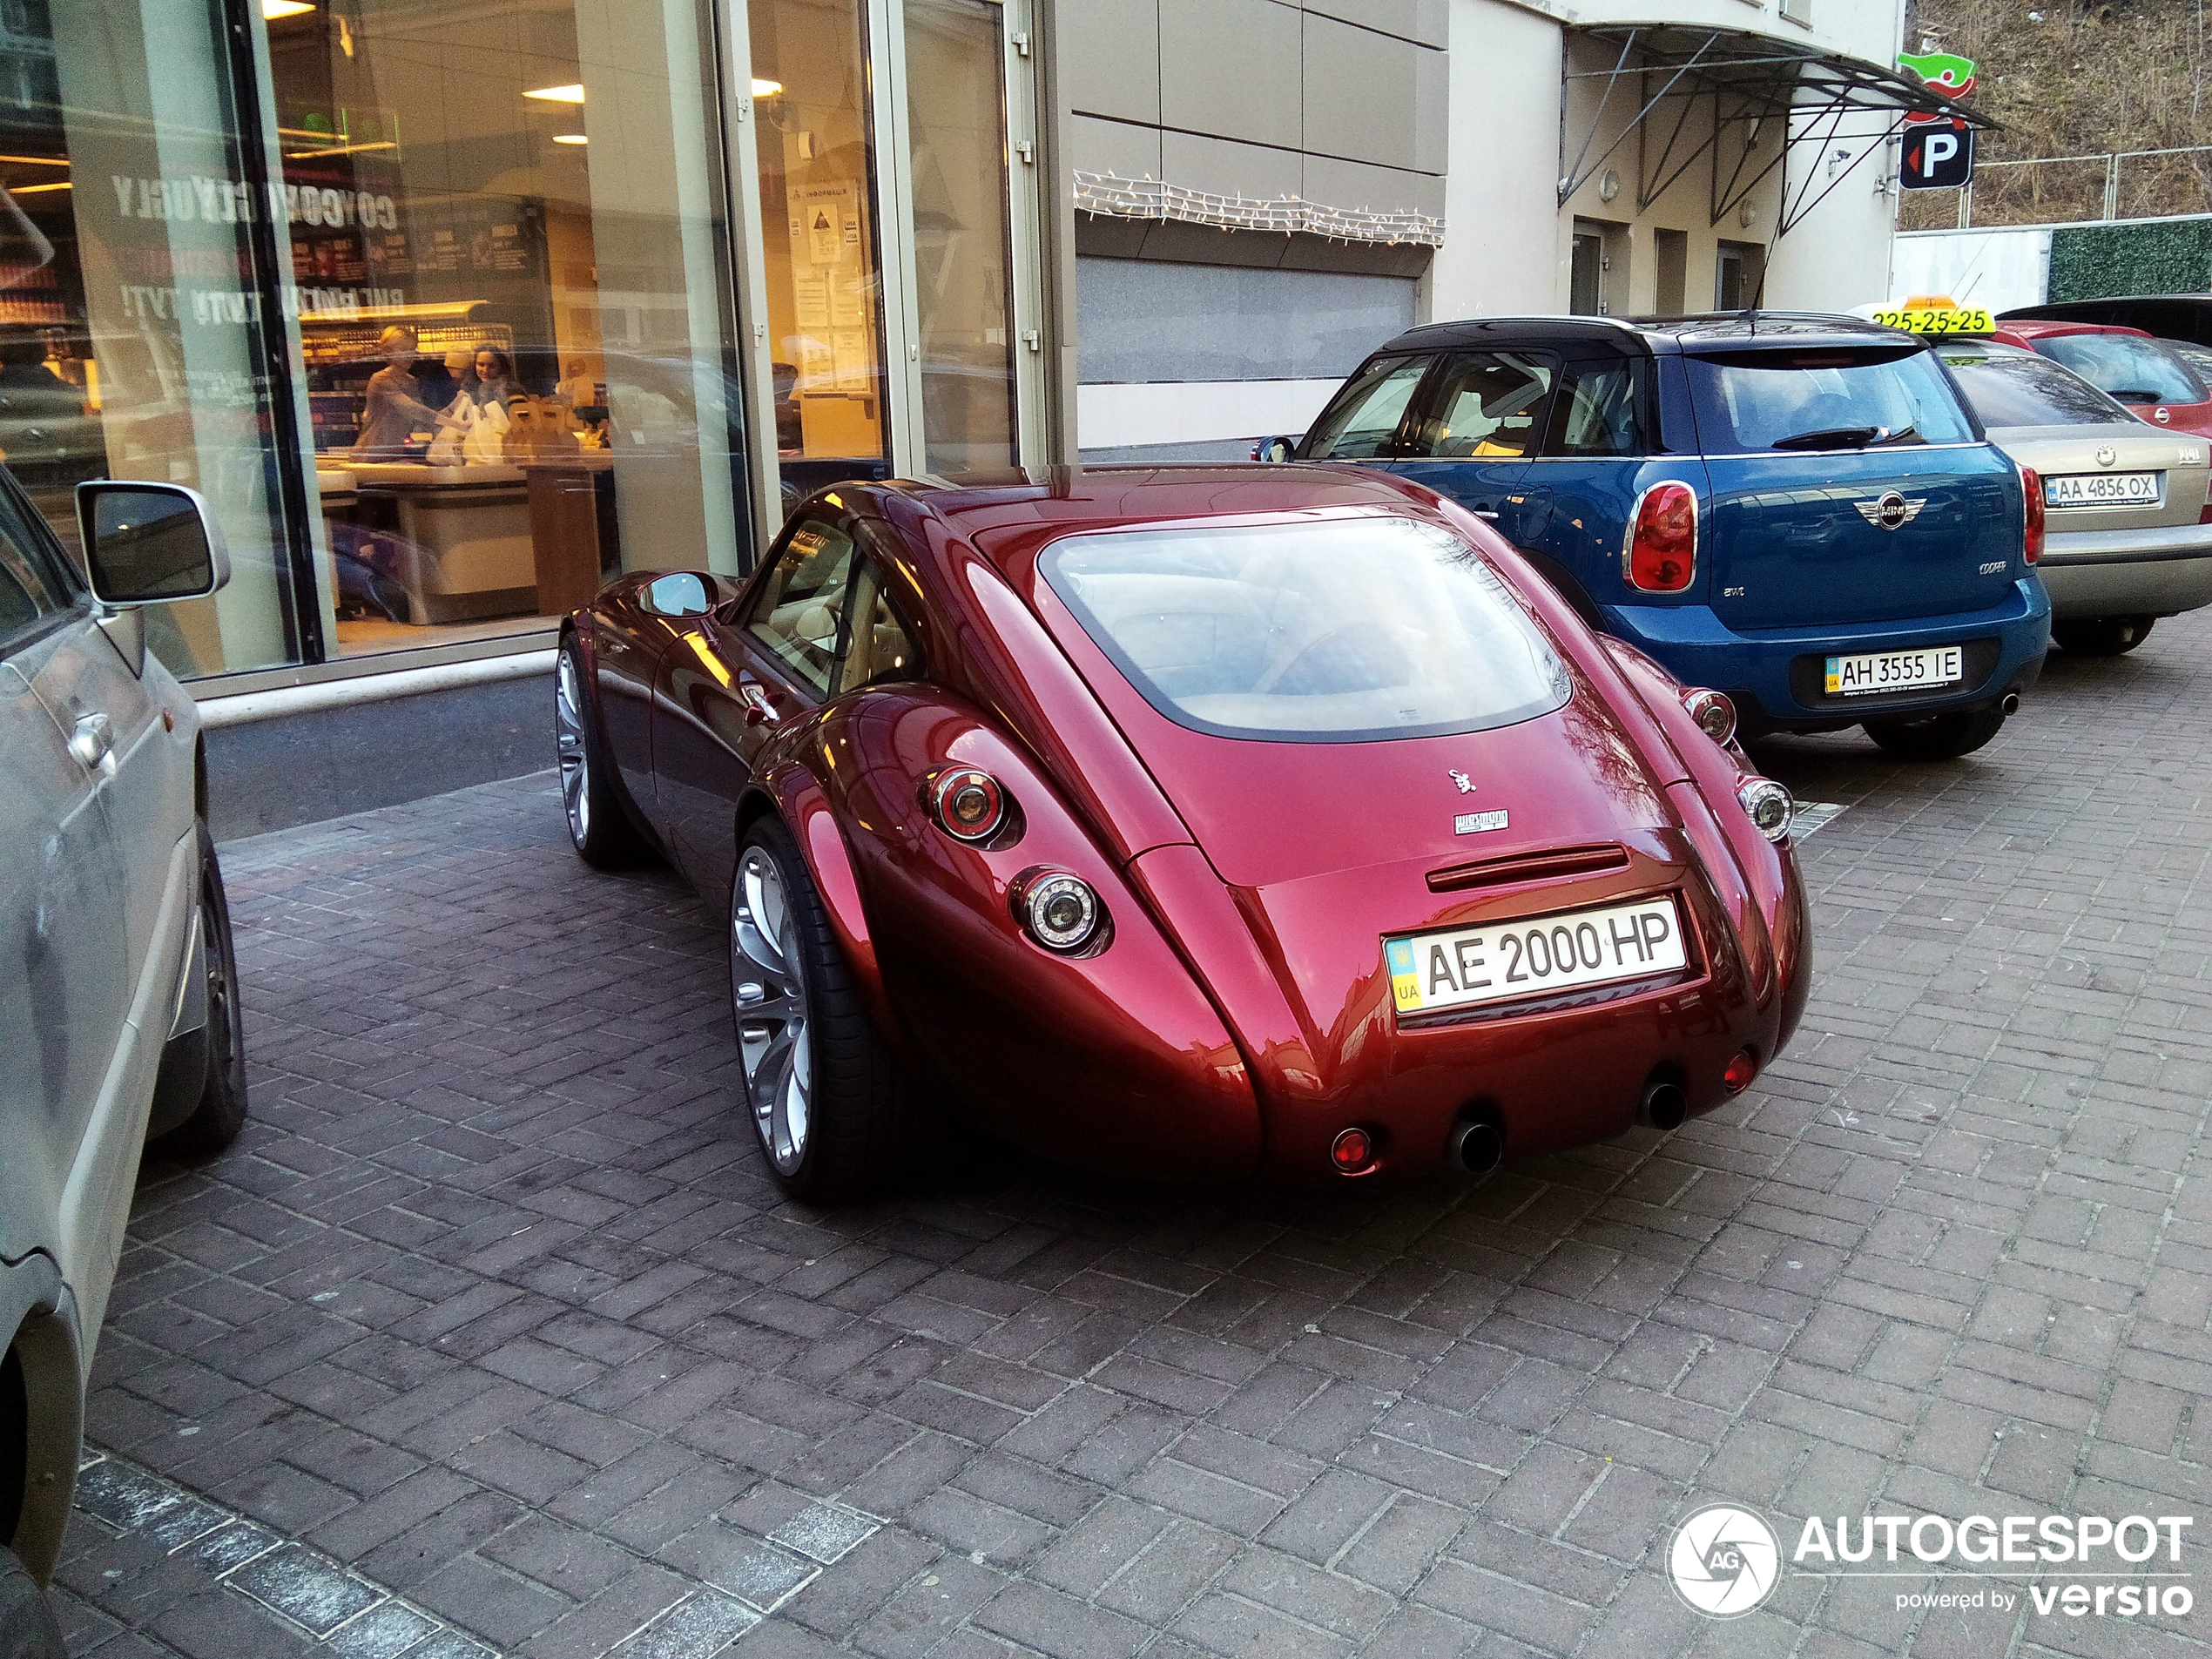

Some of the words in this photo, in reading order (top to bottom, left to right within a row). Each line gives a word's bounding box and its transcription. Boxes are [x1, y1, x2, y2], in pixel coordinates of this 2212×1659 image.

[1924, 133, 1959, 178] P
[2060, 480, 2083, 499] AA
[2088, 478, 2125, 497] 4856
[2129, 477, 2152, 495] OX
[1881, 506, 1905, 516] MINI
[1979, 561, 2006, 575] COOPER
[1842, 659, 1872, 685] AH
[1878, 655, 1925, 682] 3555
[1936, 651, 1958, 677] IE
[1429, 938, 1492, 995] AE
[1500, 922, 1602, 983] 2000
[1608, 912, 1669, 966] HP
[1399, 986, 1420, 1000] UA
